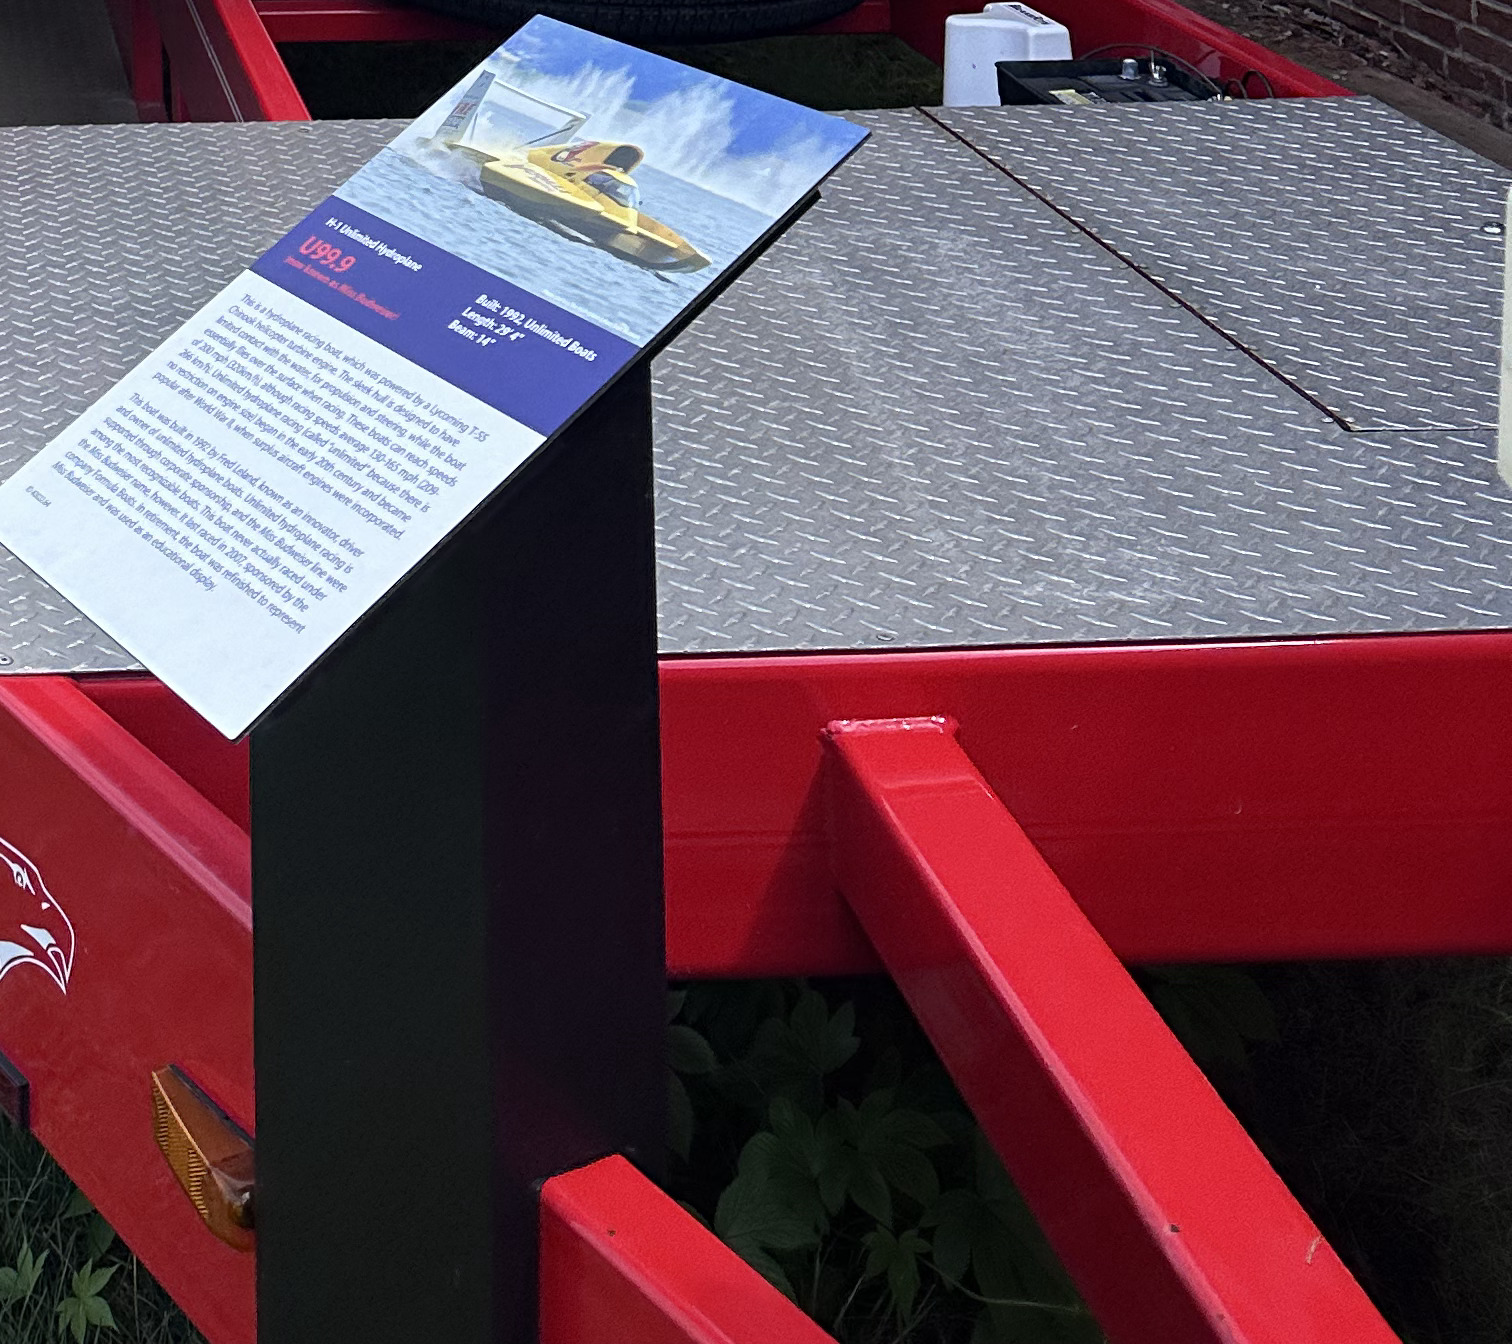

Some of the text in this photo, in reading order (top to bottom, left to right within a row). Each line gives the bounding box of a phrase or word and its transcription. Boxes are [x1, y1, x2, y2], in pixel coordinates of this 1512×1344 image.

[299, 236, 355, 272] U99.9
[325, 217, 422, 271] H-1 Unlimited Hydroplane
[240, 293, 256, 307] This
[264, 308, 303, 335] hydroplane
[301, 331, 325, 349] racing
[341, 355, 366, 371] which
[363, 367, 381, 380] was
[376, 376, 417, 400] powered
[429, 404, 469, 434] Lycoming
[253, 320, 289, 344] helicopter
[286, 340, 314, 359] turbine
[337, 369, 354, 384] The
[351, 379, 374, 395] sleek
[370, 389, 391, 404] hull
[393, 404, 433, 429] designed
[437, 428, 460, 447] have
[447, 319, 478, 340] Beam:
[461, 306, 497, 330] Length:
[475, 294, 597, 361] Built: 1992, Unlimited Boats
[151, 372, 180, 391] popular
[177, 387, 196, 401] after
[193, 396, 217, 414] World
[212, 408, 229, 423] War
[232, 424, 255, 440] when
[251, 437, 280, 457] surplus
[276, 453, 306, 474] aircraft
[302, 470, 334, 493] engines
[331, 489, 353, 506] were
[198, 341, 215, 354] 200
[211, 351, 229, 364] mph
[259, 382, 293, 405] although
[290, 401, 315, 421] racing
[312, 415, 341, 435] speeds
[338, 431, 370, 453] average
[397, 468, 419, 484] mph
[203, 328, 237, 352] essentially
[263, 364, 278, 376] the
[275, 372, 303, 391] surface
[300, 387, 323, 404] when
[346, 413, 370, 433] These
[367, 426, 392, 446] boats
[389, 443, 407, 456] can
[403, 451, 429, 469] reach
[426, 465, 458, 487] speeds
[211, 368, 247, 394] Unlimited
[241, 388, 282, 418] hydroplane
[279, 414, 304, 434] racing
[366, 467, 400, 493] because
[398, 489, 422, 508] there
[215, 393, 412, 522] engine began the early 20th century and became
[237, 330, 265, 349] contact
[277, 353, 292, 365] the
[309, 372, 324, 384] for
[319, 381, 361, 408] propulsion
[359, 404, 380, 417] and
[407, 433, 431, 450] while
[429, 445, 446, 459] the
[443, 452, 467, 471] boat
[64, 451, 94, 475] company
[91, 469, 119, 493] Formula
[178, 535, 193, 549] the
[190, 543, 211, 561] boat
[207, 557, 225, 572] was
[221, 569, 262, 599] refinished
[266, 603, 306, 634] represent
[77, 438, 91, 451] the
[184, 516, 201, 532] last
[196, 528, 222, 546] raced
[242, 562, 287, 594] sponsored
[292, 597, 309, 612] the
[90, 428, 115, 448] among
[111, 442, 126, 455] the
[122, 451, 143, 467] most
[199, 505, 216, 521] This
[213, 515, 234, 533] boat
[230, 529, 253, 548] never
[250, 544, 282, 570] actually
[278, 565, 306, 584] raced
[300, 580, 327, 601] under
[92, 493, 111, 507] and
[104, 503, 121, 516] was
[117, 513, 140, 529] used
[151, 538, 195, 571] educational
[115, 405, 134, 418] and
[155, 433, 190, 457] unlimited
[184, 451, 224, 483] hydroplane
[243, 493, 283, 522] Unlimited
[277, 516, 321, 551] hydroplane
[318, 547, 346, 570] racing
[128, 392, 144, 406] This
[140, 400, 160, 417] boat
[156, 412, 172, 426] was
[168, 419, 188, 436] built
[215, 453, 238, 469] Fred
[257, 480, 284, 503] known
[338, 538, 364, 557] driver
[133, 437, 162, 460] through
[159, 456, 193, 482] corporate
[230, 508, 251, 522] and
[245, 517, 261, 531] the
[309, 561, 327, 578] line
[325, 574, 348, 592] were
